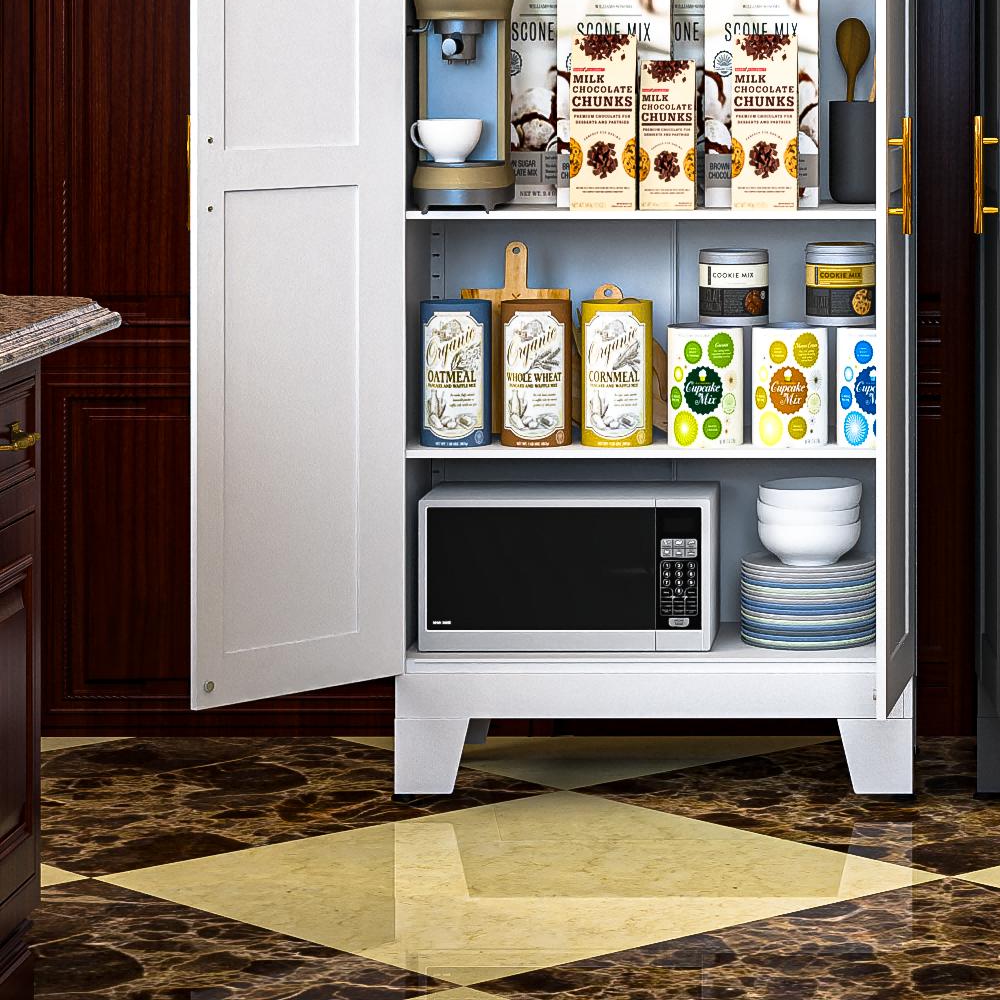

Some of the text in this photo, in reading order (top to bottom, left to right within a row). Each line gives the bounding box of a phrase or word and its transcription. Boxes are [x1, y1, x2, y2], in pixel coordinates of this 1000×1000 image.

[511, 21, 555, 42] SCONE
[577, 22, 651, 42] SCONE MIX
[674, 21, 700, 42] ONE
[724, 22, 798, 42] SCONE MIX
[573, 75, 605, 83] MILK
[735, 75, 767, 83] MILK
[572, 96, 633, 107] CHUNKS
[641, 94, 669, 102] MILK
[734, 96, 795, 107] CHUNKS
[641, 112, 693, 122] CHUNKS
[709, 162, 730, 170] BROWN
[708, 172, 731, 180] CHOCOL
[819, 271, 847, 279] COOKIE
[427, 370, 477, 384] OATMEAL
[506, 371, 562, 383] WHOLE WHEAT
[589, 370, 640, 383] CORNMEAL
[685, 381, 721, 396] Cupcake
[770, 381, 806, 396] Cupcake
[696, 392, 717, 405] Mix
[782, 392, 802, 405] Mix
